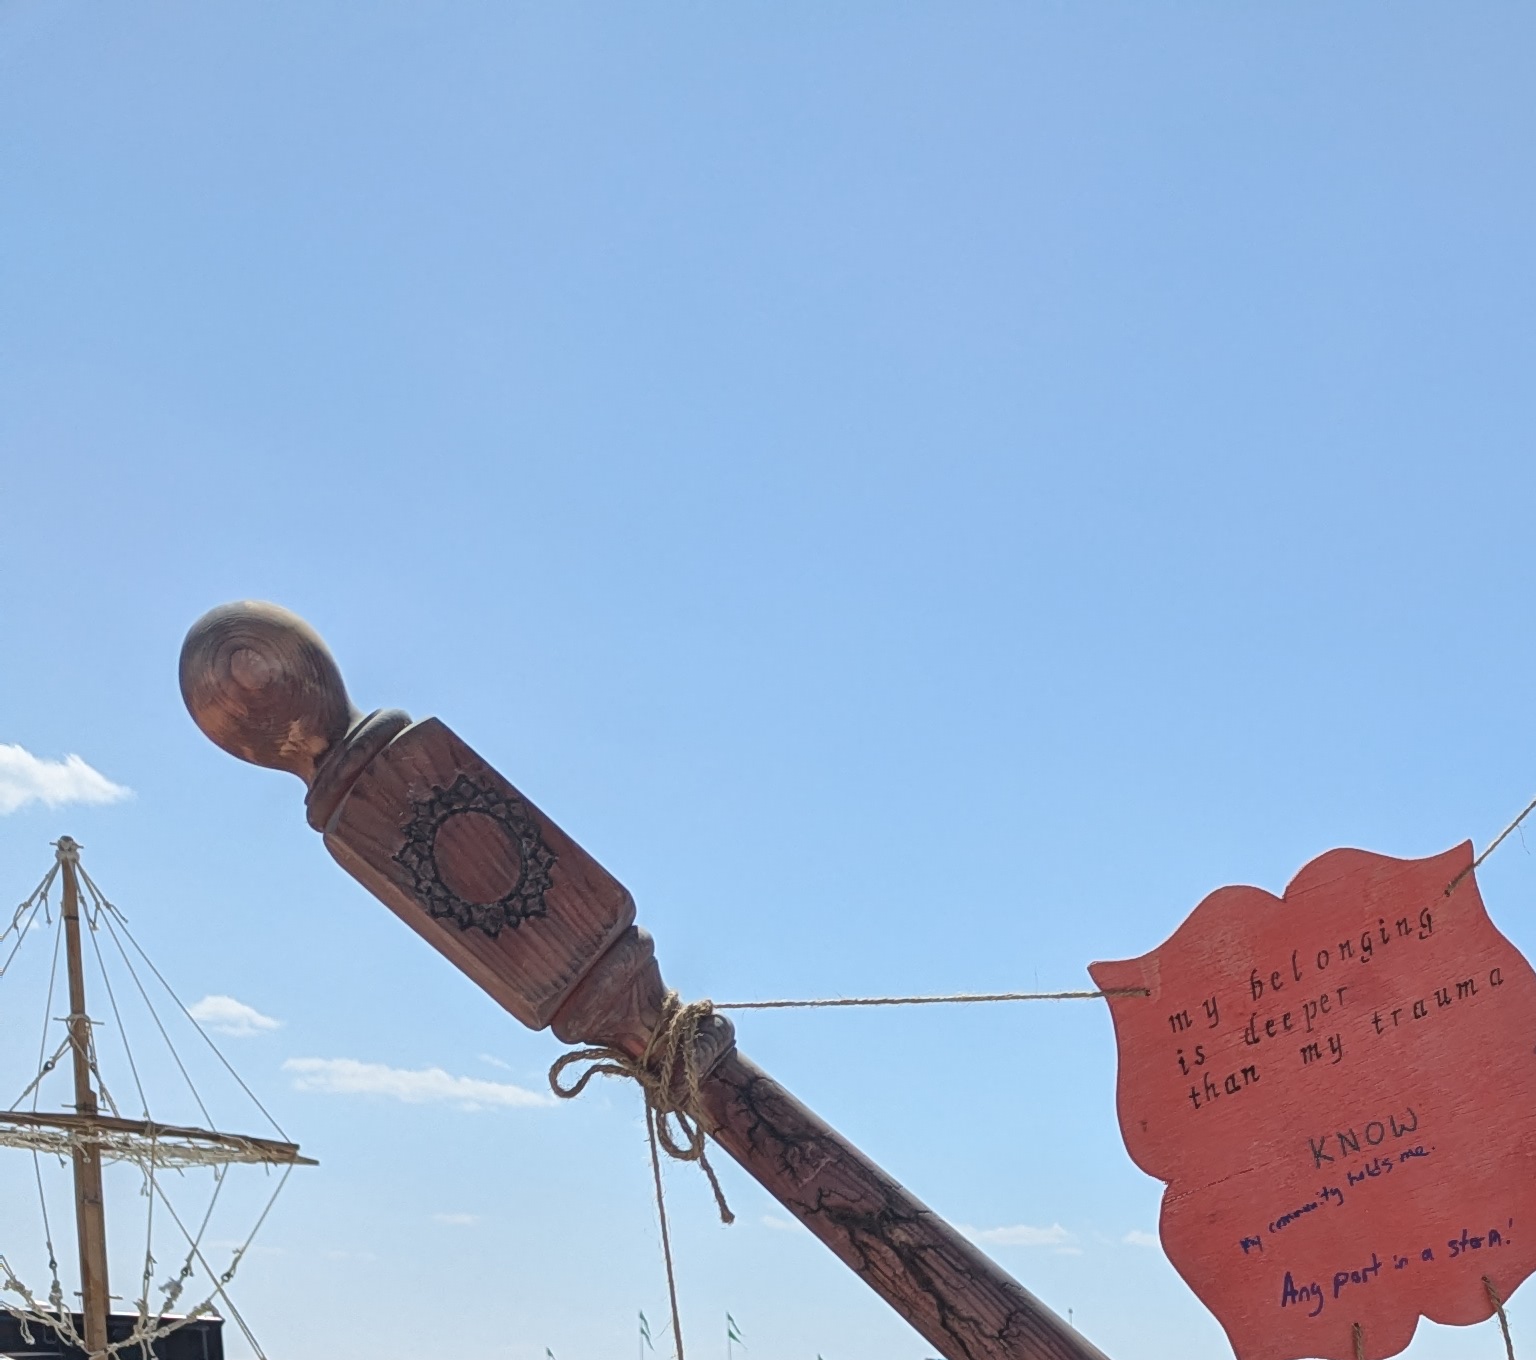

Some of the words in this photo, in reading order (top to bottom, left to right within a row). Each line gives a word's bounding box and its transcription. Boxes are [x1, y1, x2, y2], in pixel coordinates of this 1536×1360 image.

[1169, 999, 1220, 1033] my
[1251, 907, 1434, 999] belonging
[1178, 1045, 1206, 1075] is
[1244, 987, 1348, 1047] deeper
[1189, 1065, 1260, 1109] than
[1300, 1033, 1344, 1063] my
[1372, 966, 1505, 1034] trauma
[1309, 1107, 1420, 1169] KNOW
[1347, 1157, 1394, 1185] holds
[1282, 1273, 1323, 1317] Any
[1393, 1254, 1409, 1270] in
[1421, 1249, 1433, 1262] a
